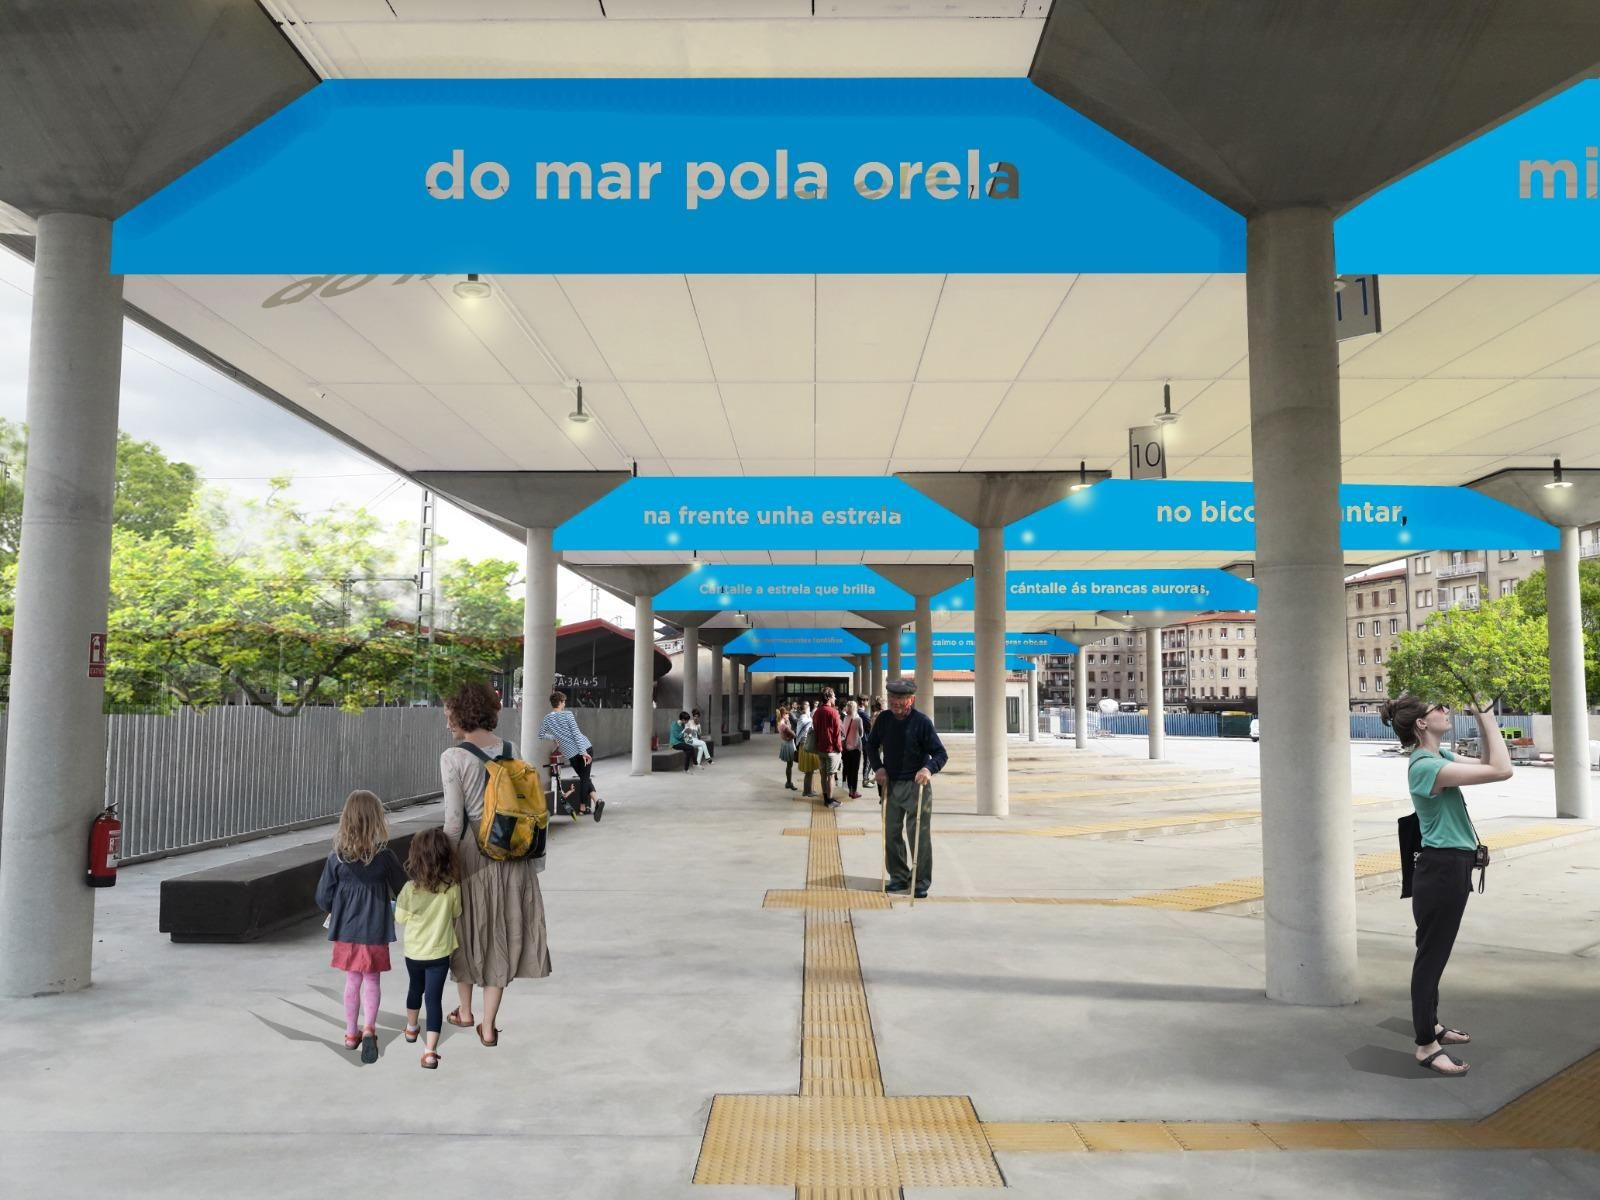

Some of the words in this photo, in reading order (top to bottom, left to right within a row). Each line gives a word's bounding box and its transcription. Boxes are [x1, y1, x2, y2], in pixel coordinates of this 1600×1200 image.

[425, 149, 510, 200] do
[536, 161, 662, 200] mar
[687, 149, 828, 210] pola
[853, 149, 1020, 200] orela
[1132, 441, 1161, 469] 10
[643, 511, 671, 525] na
[679, 506, 750, 525] frente
[757, 506, 814, 525] unha
[821, 505, 902, 525] estrela
[1156, 504, 1192, 523] no
[767, 584, 811, 595] estrela
[815, 585, 838, 597] que
[842, 583, 876, 595] brilla
[1010, 582, 1067, 595] cántalle
[1071, 582, 1088, 595] ás
[1091, 582, 1148, 595] brancas
[1152, 584, 1210, 597] auroras,
